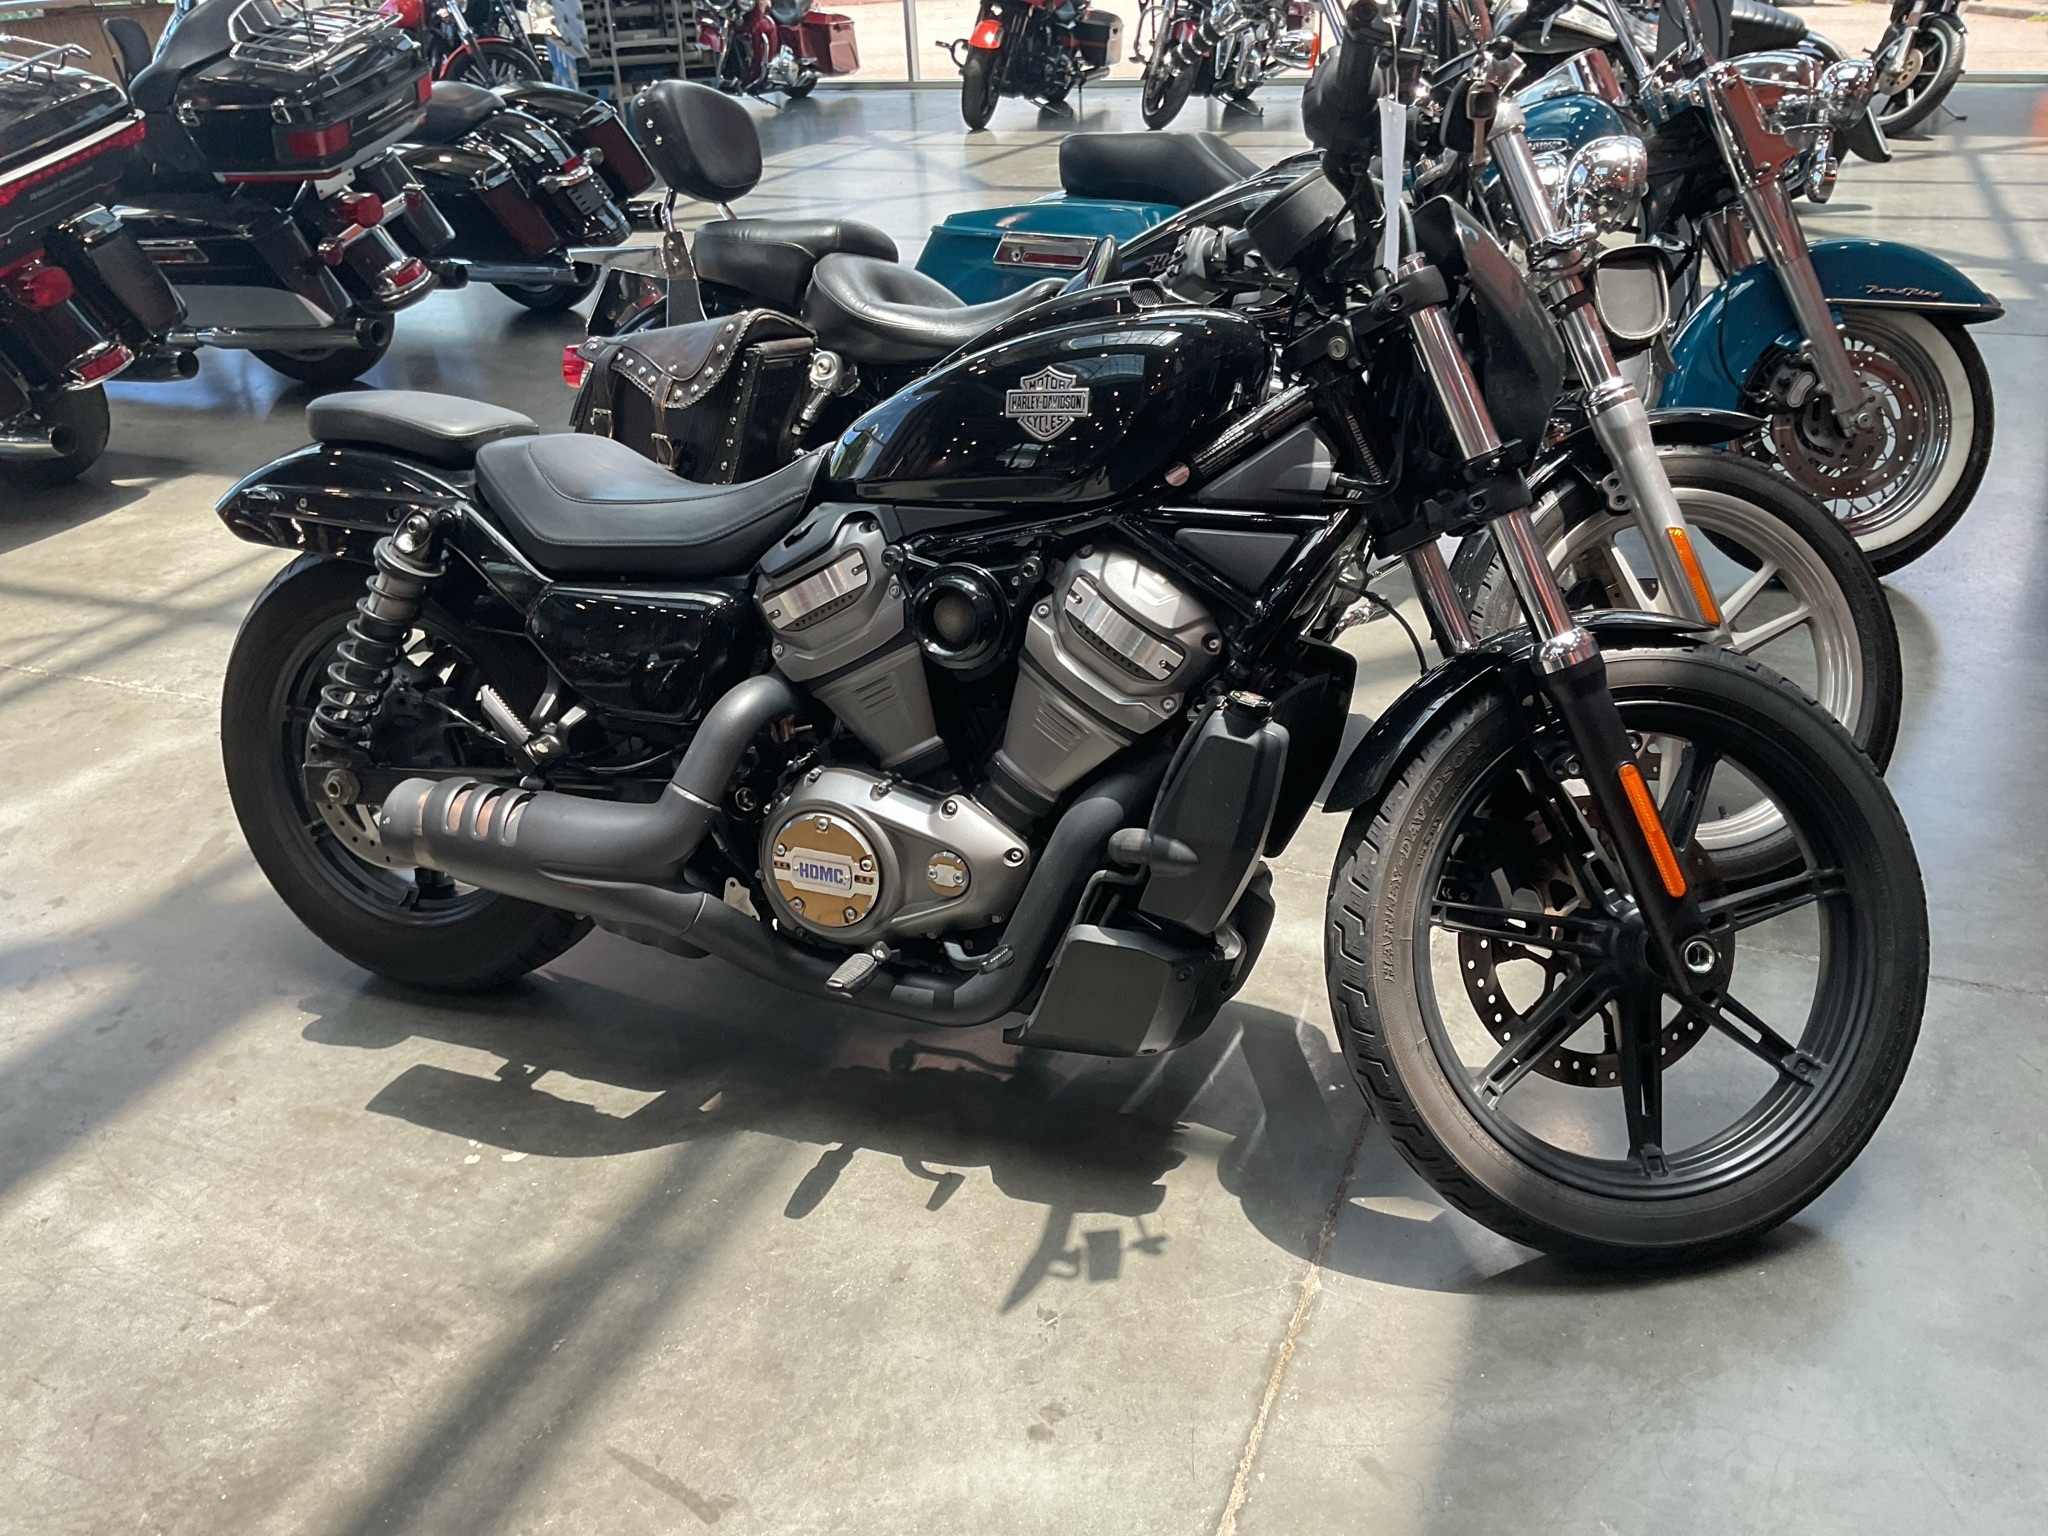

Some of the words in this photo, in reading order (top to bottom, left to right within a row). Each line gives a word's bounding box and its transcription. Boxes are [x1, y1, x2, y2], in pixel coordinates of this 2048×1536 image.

[1028, 374, 1066, 390] MOTOR
[1011, 394, 1082, 410] HARLEY-DAVIDSON
[1026, 415, 1064, 434] CYCLES
[1383, 735, 1482, 984] HARLEY-DAVIDSON
